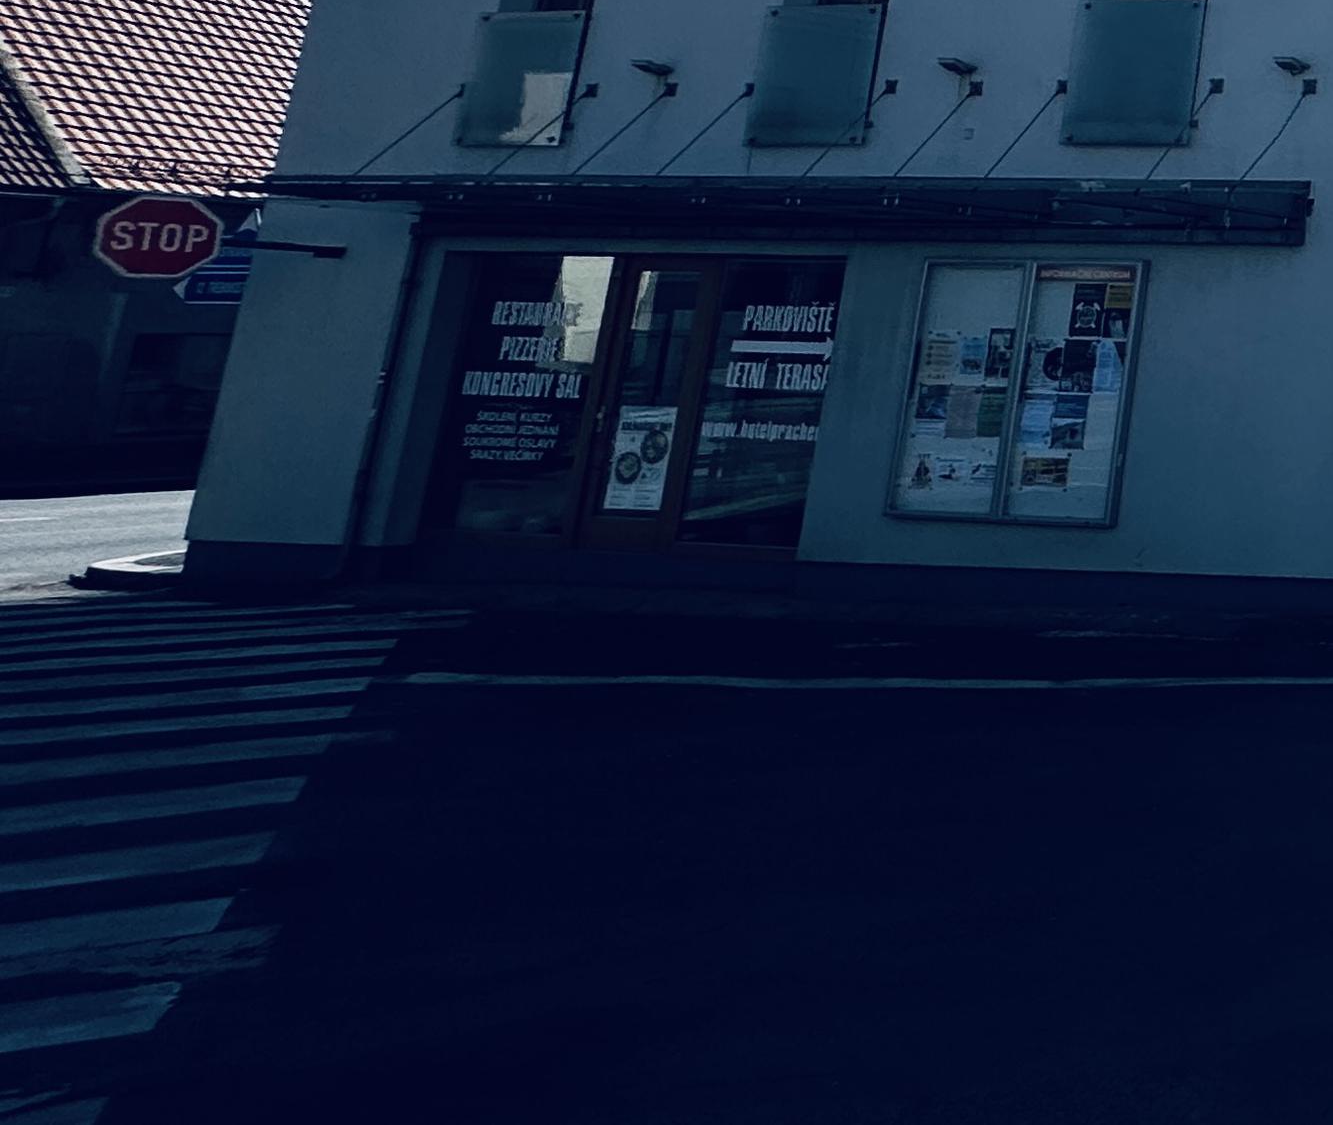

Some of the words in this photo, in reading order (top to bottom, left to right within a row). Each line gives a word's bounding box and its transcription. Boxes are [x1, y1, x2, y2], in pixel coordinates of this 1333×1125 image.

[110, 220, 210, 253] STOP
[742, 301, 836, 334] PARKOVIŠTĚ
[725, 357, 770, 389] LETNÍ
